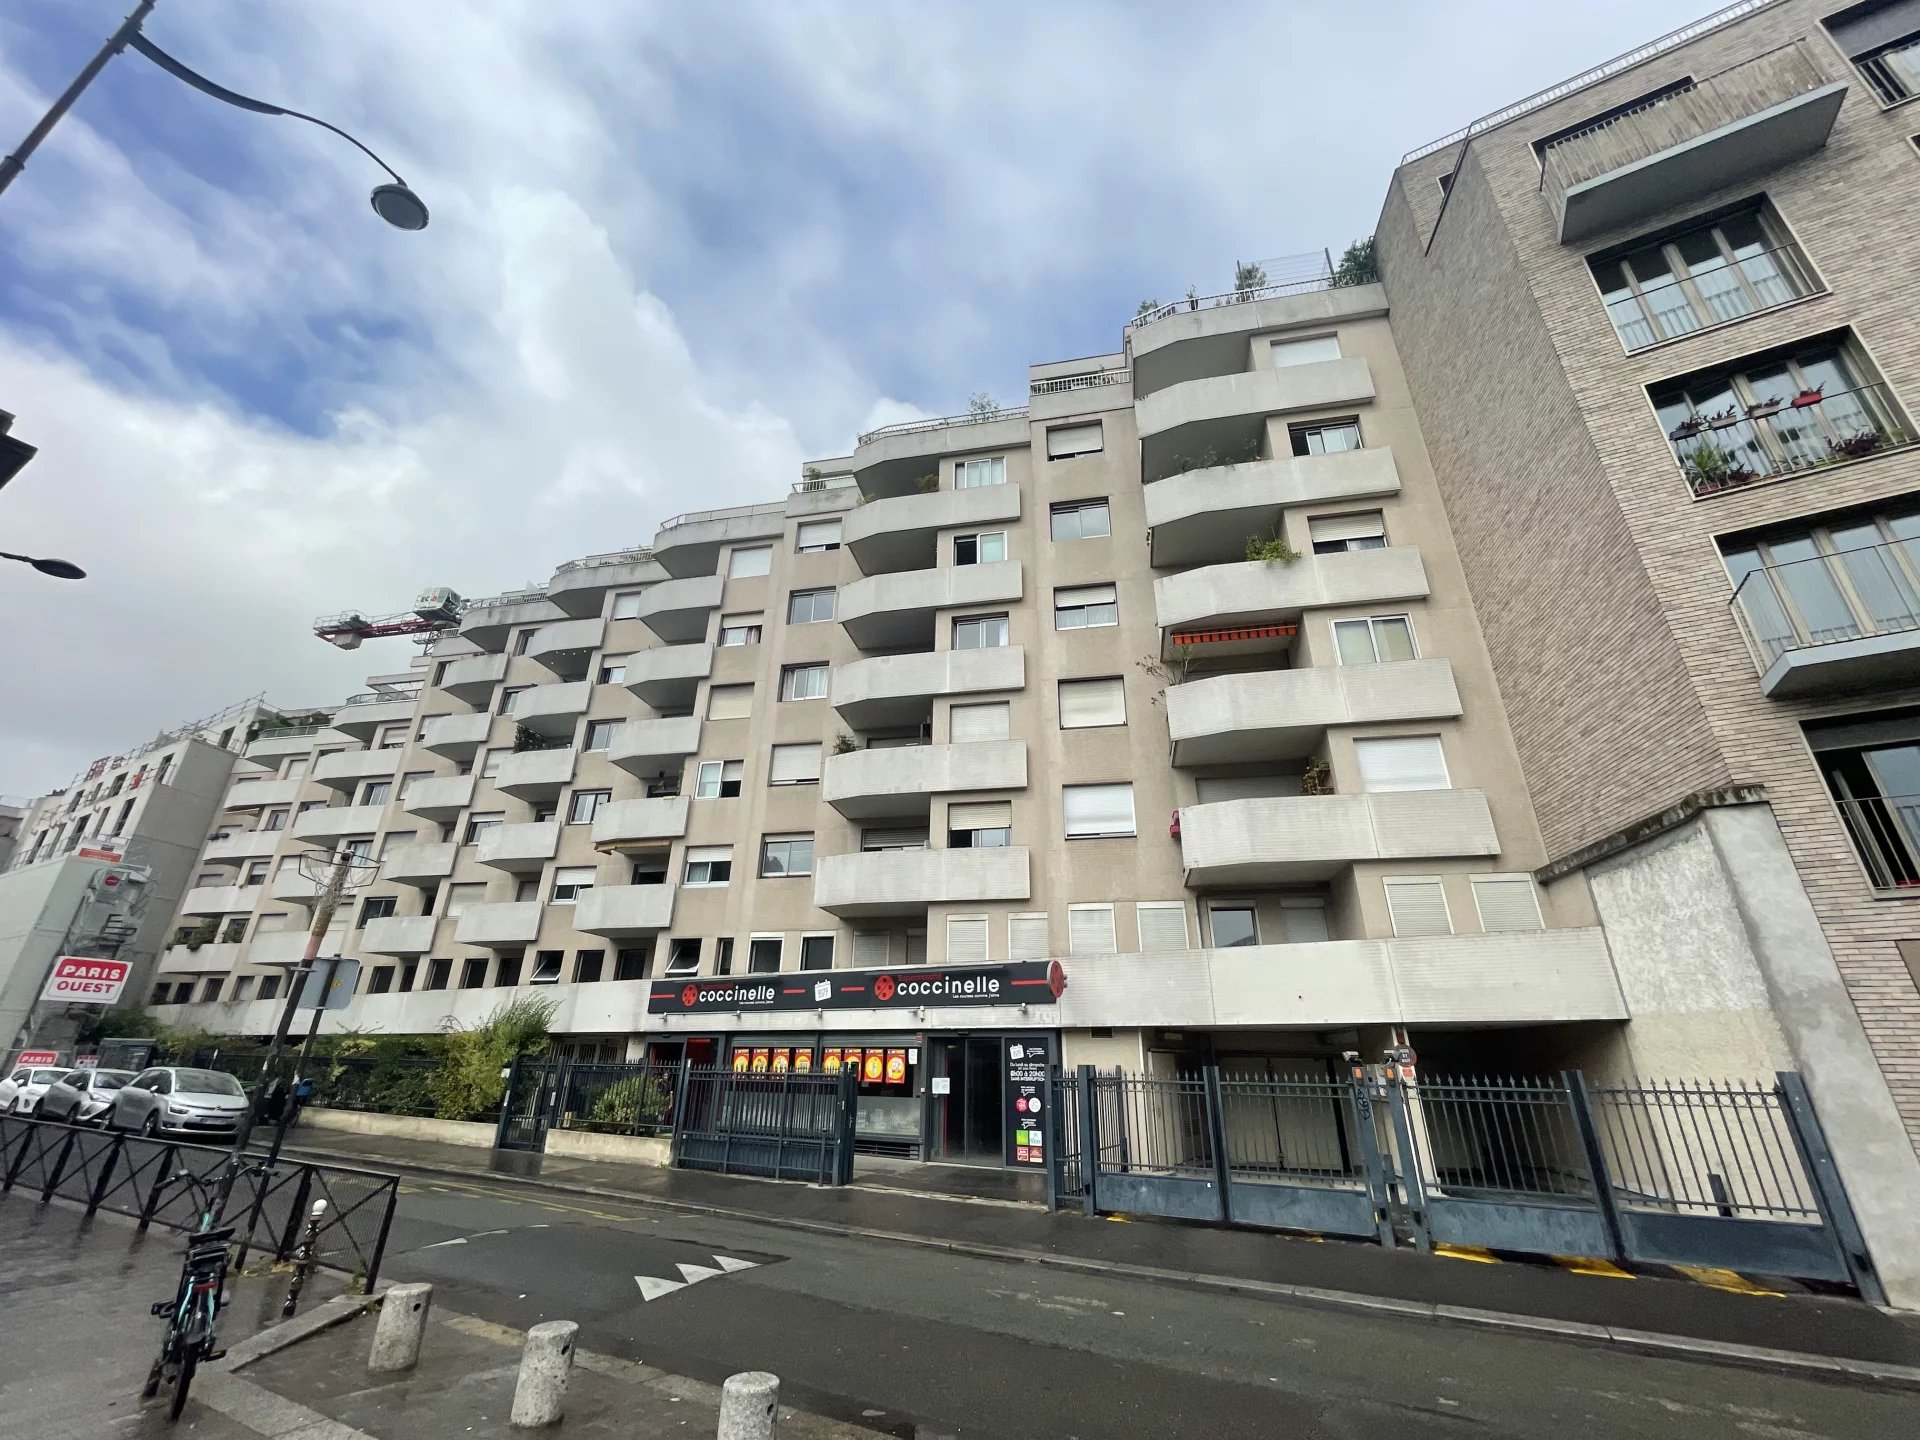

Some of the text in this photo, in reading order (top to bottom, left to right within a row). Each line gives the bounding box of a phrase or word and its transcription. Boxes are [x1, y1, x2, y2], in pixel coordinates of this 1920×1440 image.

[62, 965, 121, 980] PARIS
[56, 981, 115, 994] OUEST
[897, 976, 1000, 995] coccinelle
[699, 985, 775, 1002] coccinelle
[22, 1055, 53, 1064] PARIS
